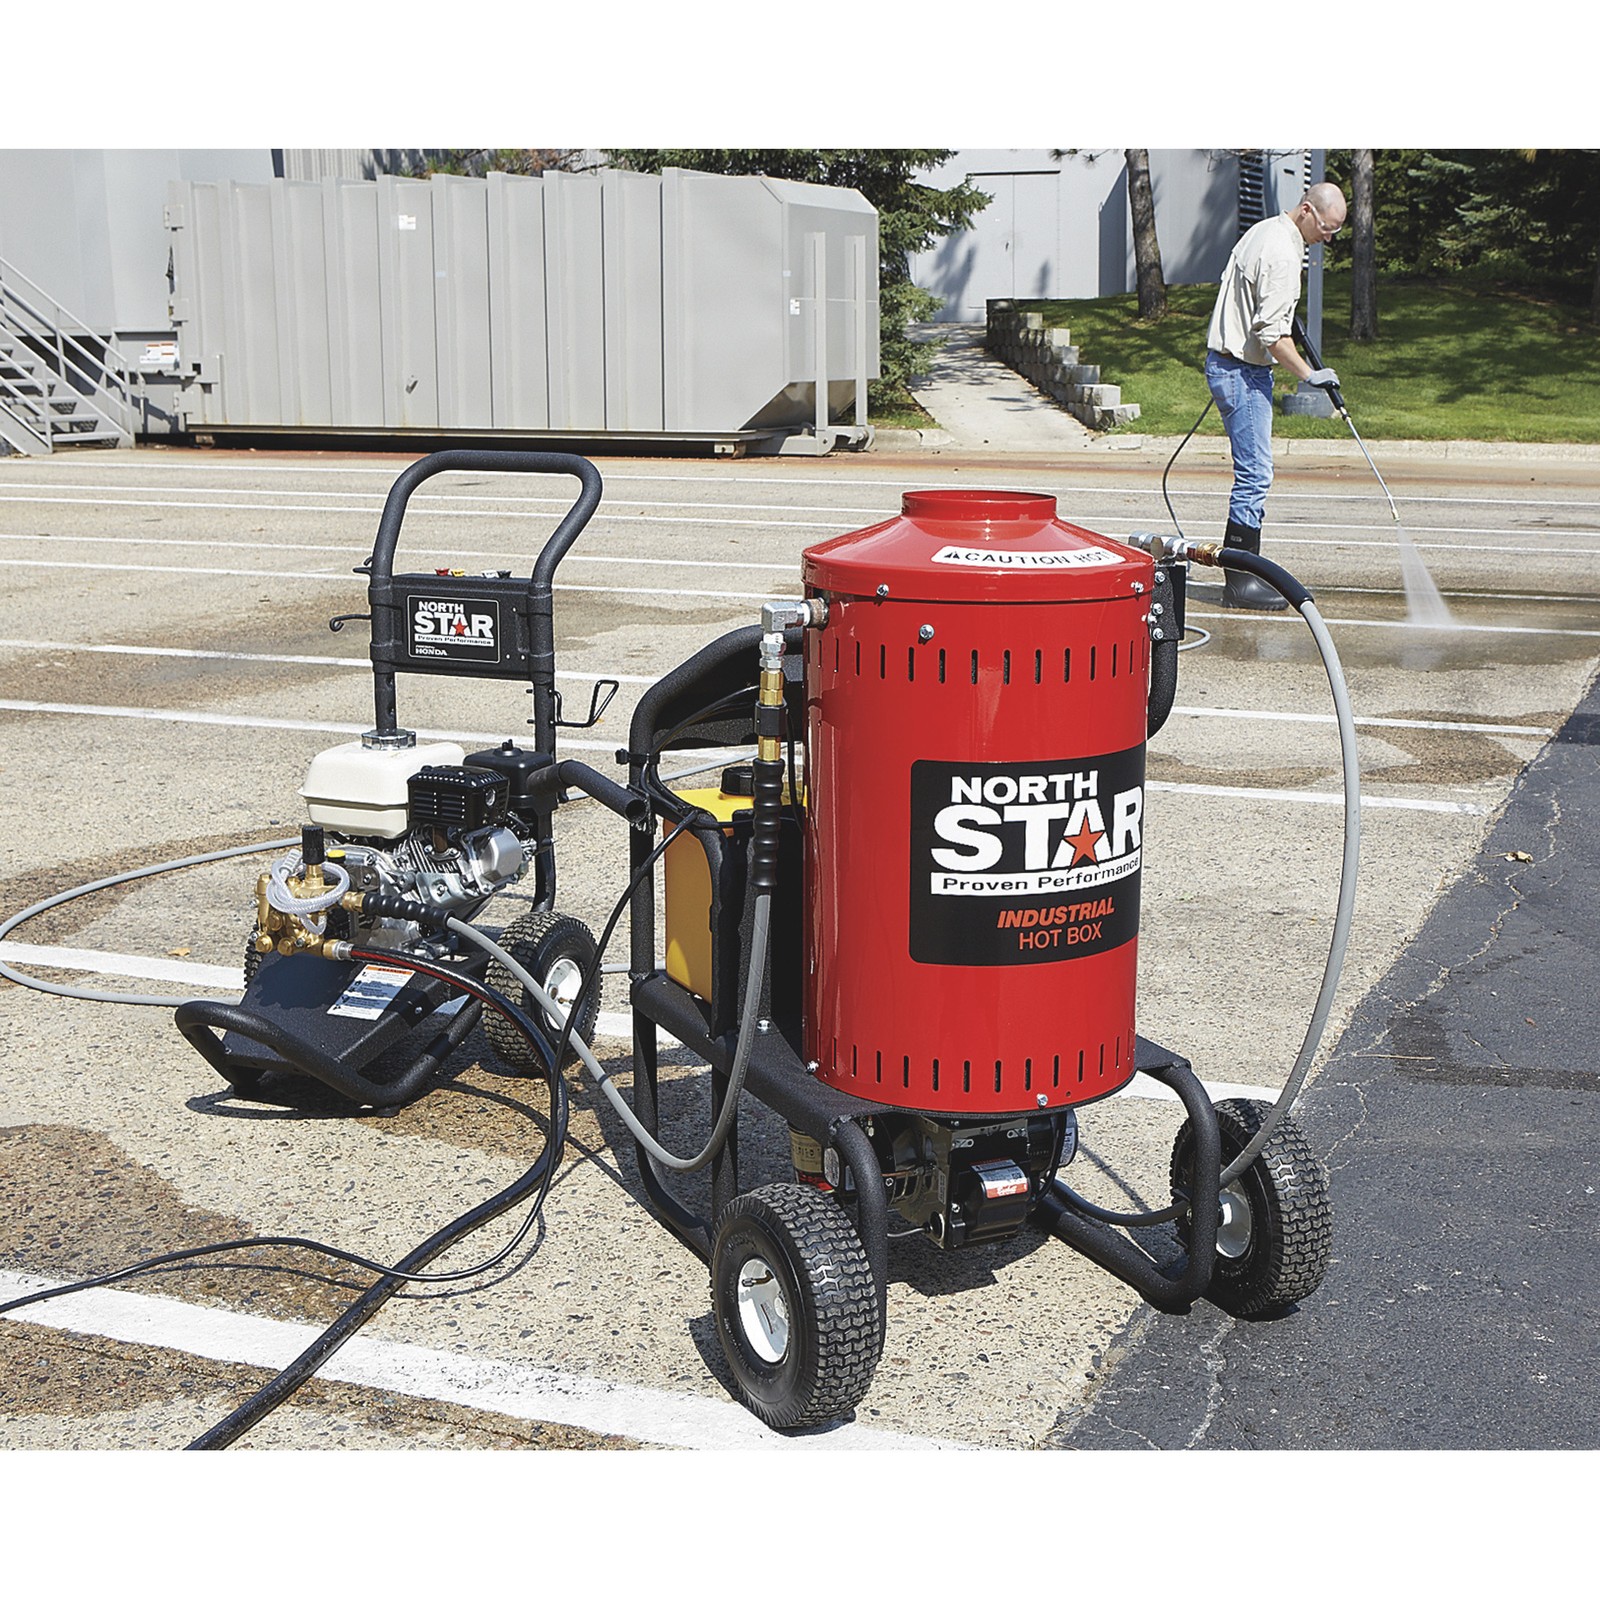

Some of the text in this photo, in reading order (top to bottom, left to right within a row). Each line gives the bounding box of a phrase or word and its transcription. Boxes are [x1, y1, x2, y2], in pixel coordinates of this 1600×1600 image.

[965, 552, 1071, 565] CAUTION
[418, 600, 464, 613] NORTH
[414, 610, 494, 639] STAR
[415, 648, 448, 656] HONDA
[444, 636, 492, 646] Performance
[951, 770, 1099, 805] NORTH
[930, 785, 1143, 872] STAR
[942, 857, 1140, 891] Proven Performance
[996, 896, 1116, 929] INDUSTRIAL
[1018, 921, 1103, 950] HOT BOX
